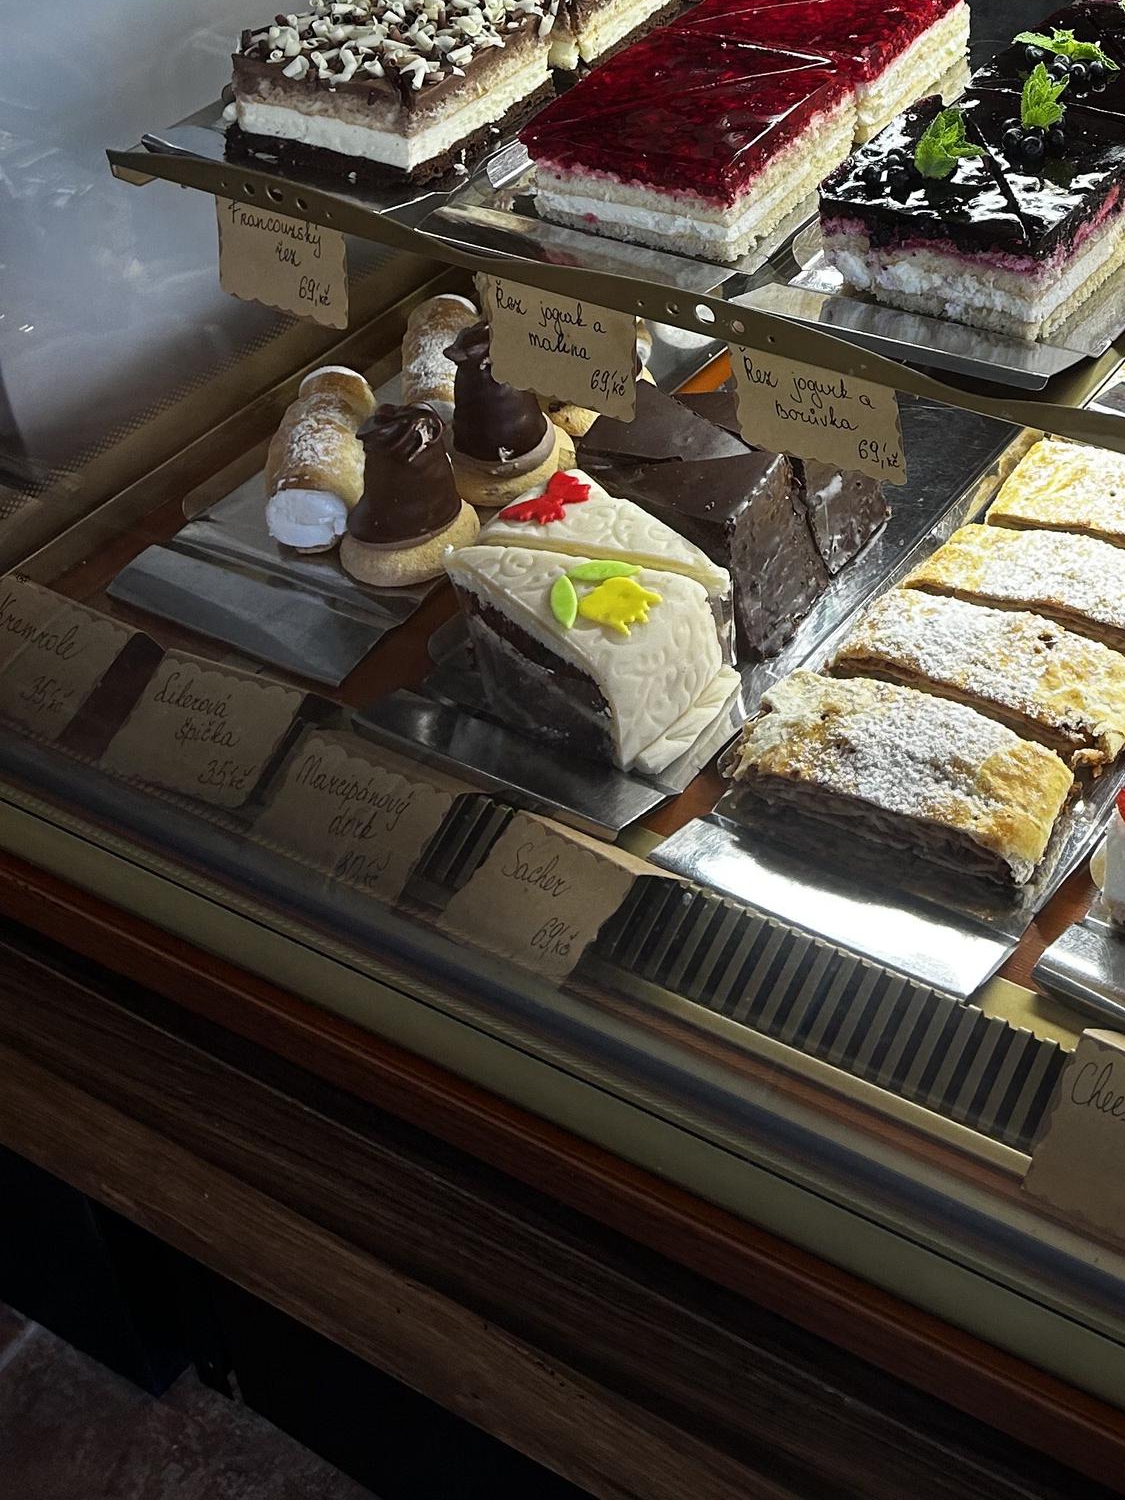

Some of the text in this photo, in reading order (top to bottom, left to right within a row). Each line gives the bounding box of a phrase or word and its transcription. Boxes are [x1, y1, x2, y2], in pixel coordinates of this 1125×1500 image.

[593, 320, 607, 334] a
[859, 394, 876, 409] a
[501, 842, 572, 897] Sacher
